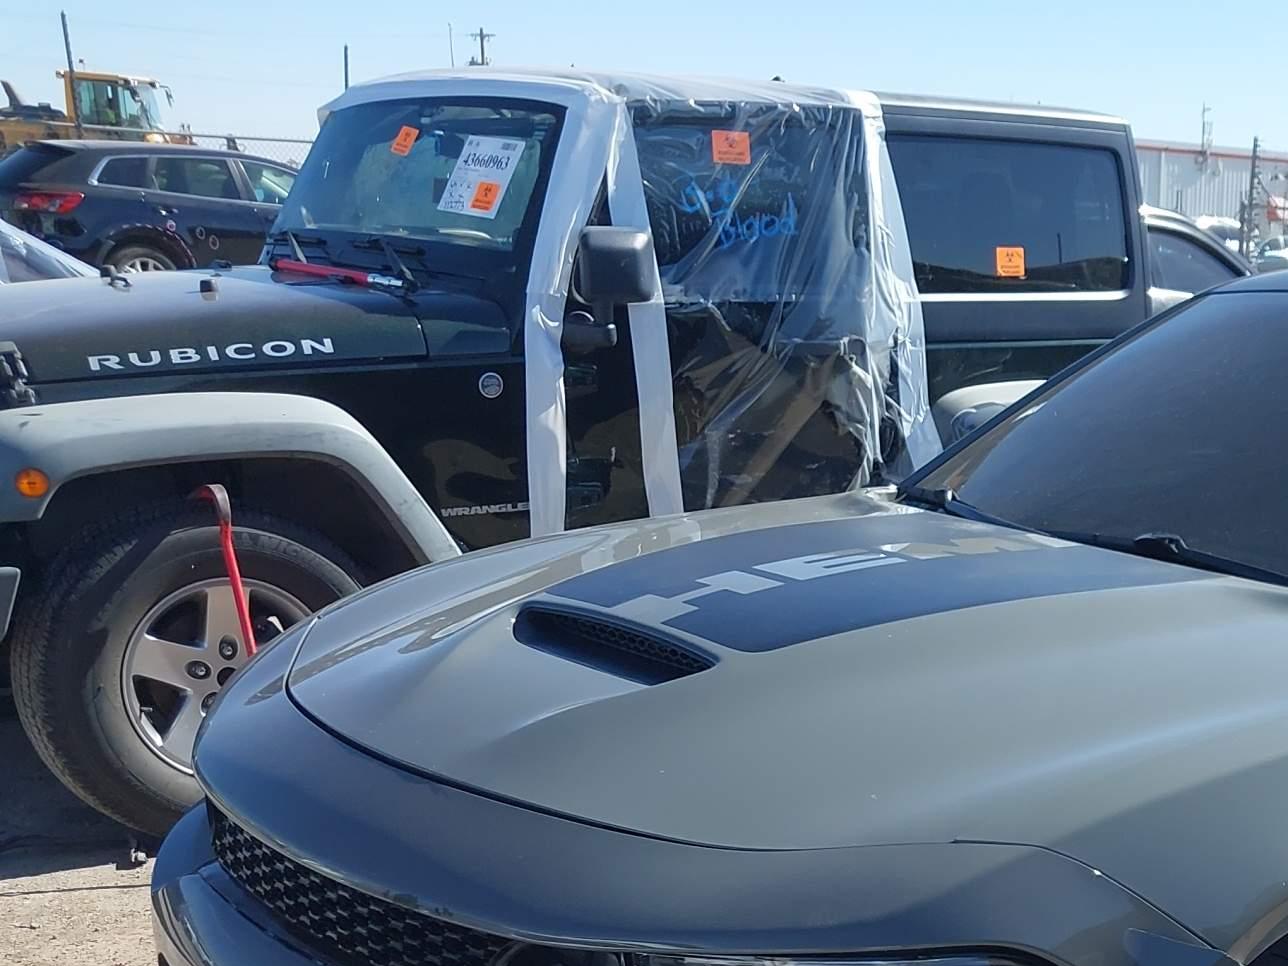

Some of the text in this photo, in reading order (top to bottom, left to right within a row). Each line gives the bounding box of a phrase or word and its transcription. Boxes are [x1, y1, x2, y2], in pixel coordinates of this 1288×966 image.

[463, 151, 511, 171] 43660963
[87, 337, 335, 371] RUBICON
[440, 501, 531, 517] WRANGLE
